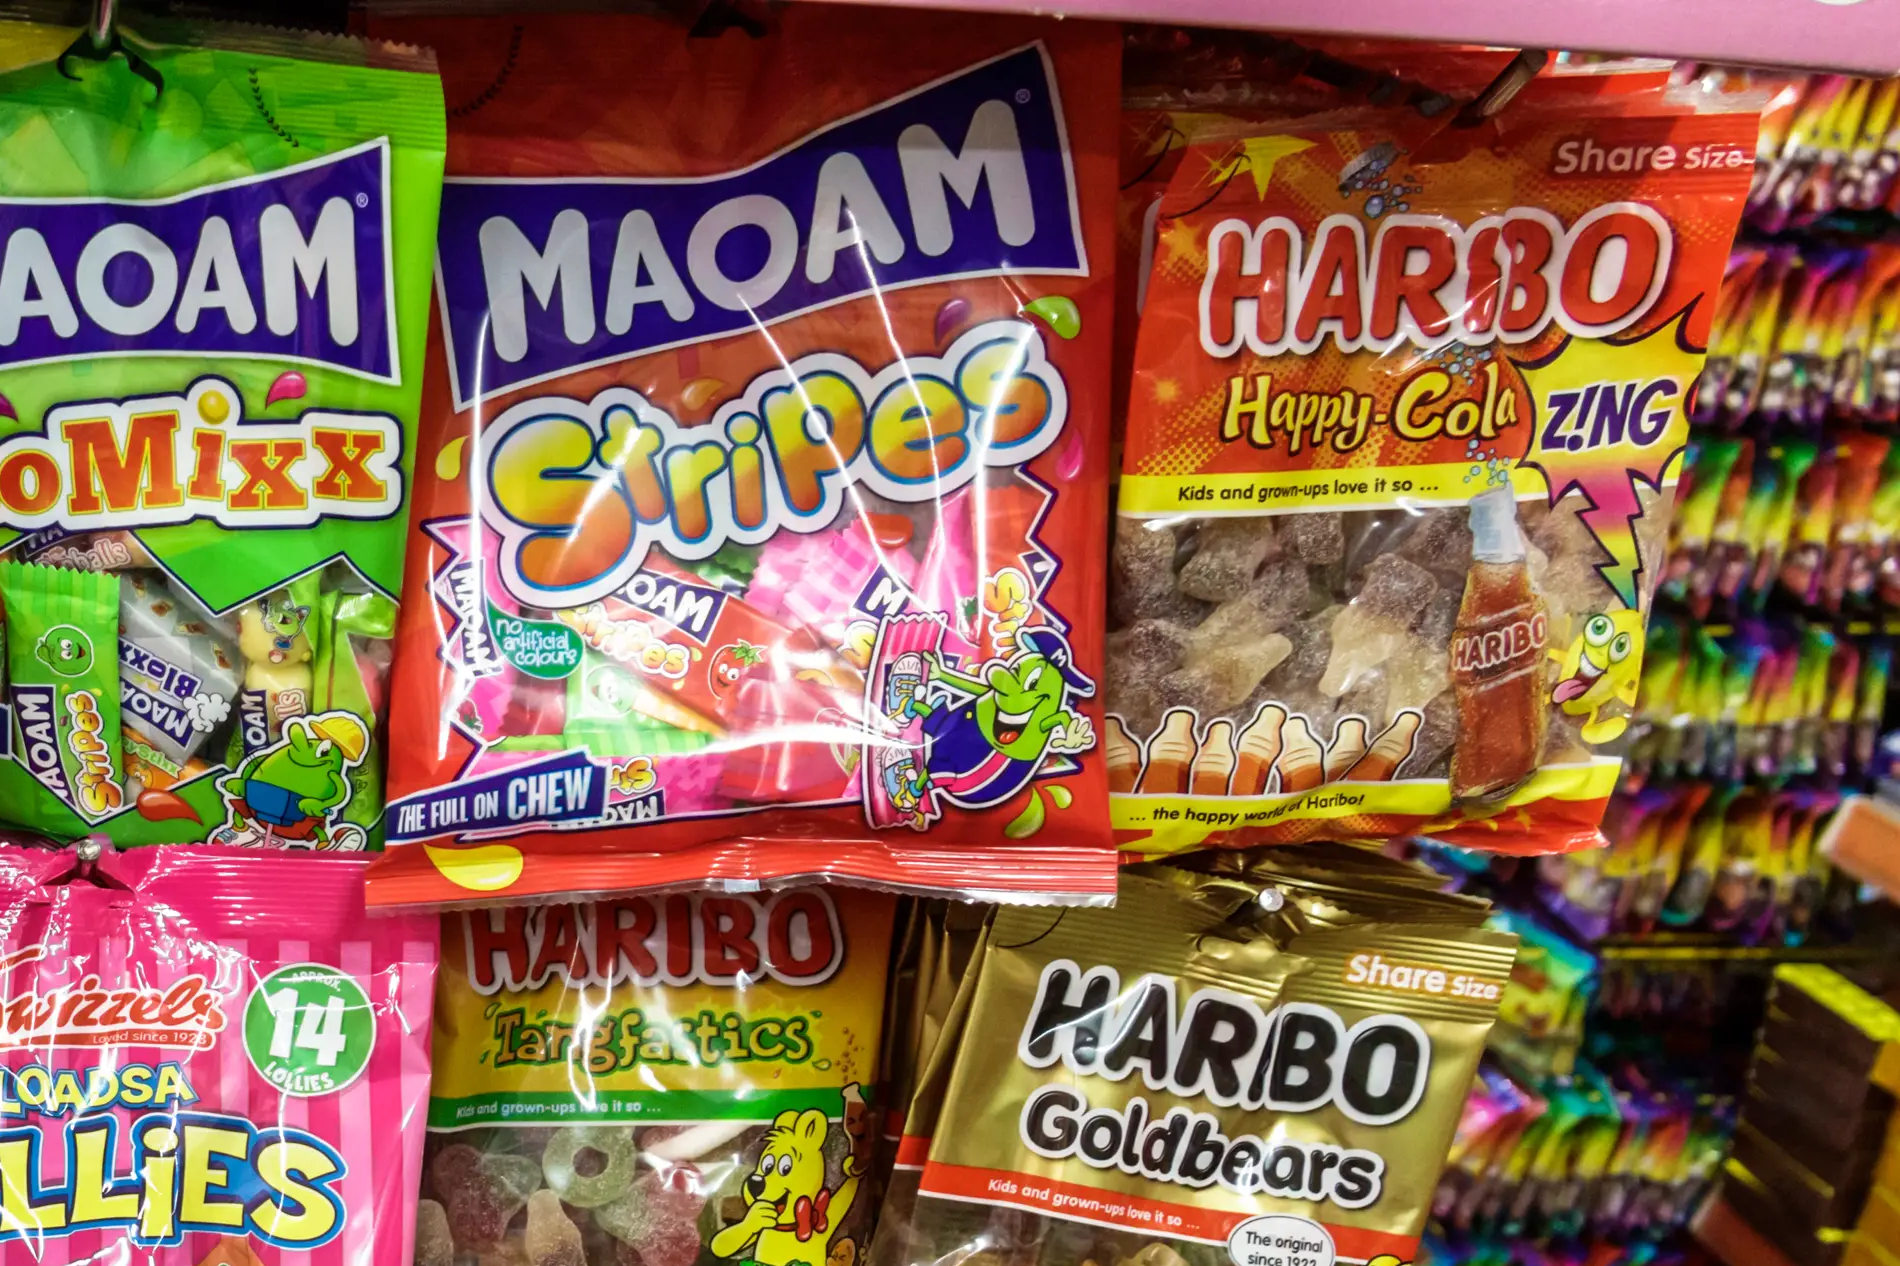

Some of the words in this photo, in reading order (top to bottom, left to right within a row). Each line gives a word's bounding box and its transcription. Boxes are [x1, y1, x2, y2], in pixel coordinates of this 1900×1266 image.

[477, 98, 1037, 364] MAOAM
[1200, 202, 1674, 357] HARIBO
[1221, 361, 1519, 457] Happy-Cola
[1540, 375, 1678, 455] Z!NG
[487, 331, 1057, 595] Stripes
[1178, 482, 1215, 502] Kids
[1219, 482, 1254, 501] and
[1258, 480, 1330, 503] grown-ups
[1333, 476, 1369, 496] love
[1374, 475, 1387, 493] it
[1390, 476, 1414, 493] so
[496, 618, 523, 636] no
[503, 631, 569, 653] artificial
[514, 648, 578, 667] colours
[1453, 614, 1549, 672] HARIBO
[65, 690, 125, 817] Stripes
[398, 805, 427, 833] THE
[429, 797, 471, 827] FULL
[473, 790, 500, 819] ON
[507, 768, 593, 821] CHEW
[466, 894, 845, 995] HARIBO
[1346, 954, 1446, 993] Share
[1450, 975, 1501, 1001] Size
[270, 987, 347, 1068] 14
[1021, 1089, 1384, 1210] Goldbears
[987, 1177, 1019, 1198] Kids
[1022, 1182, 1050, 1200] and
[1053, 1188, 1124, 1217] grown-ups
[1127, 1204, 1152, 1221] love
[1167, 1211, 1184, 1227] so
[1244, 1229, 1268, 1248] The
[1271, 1233, 1324, 1257] original
